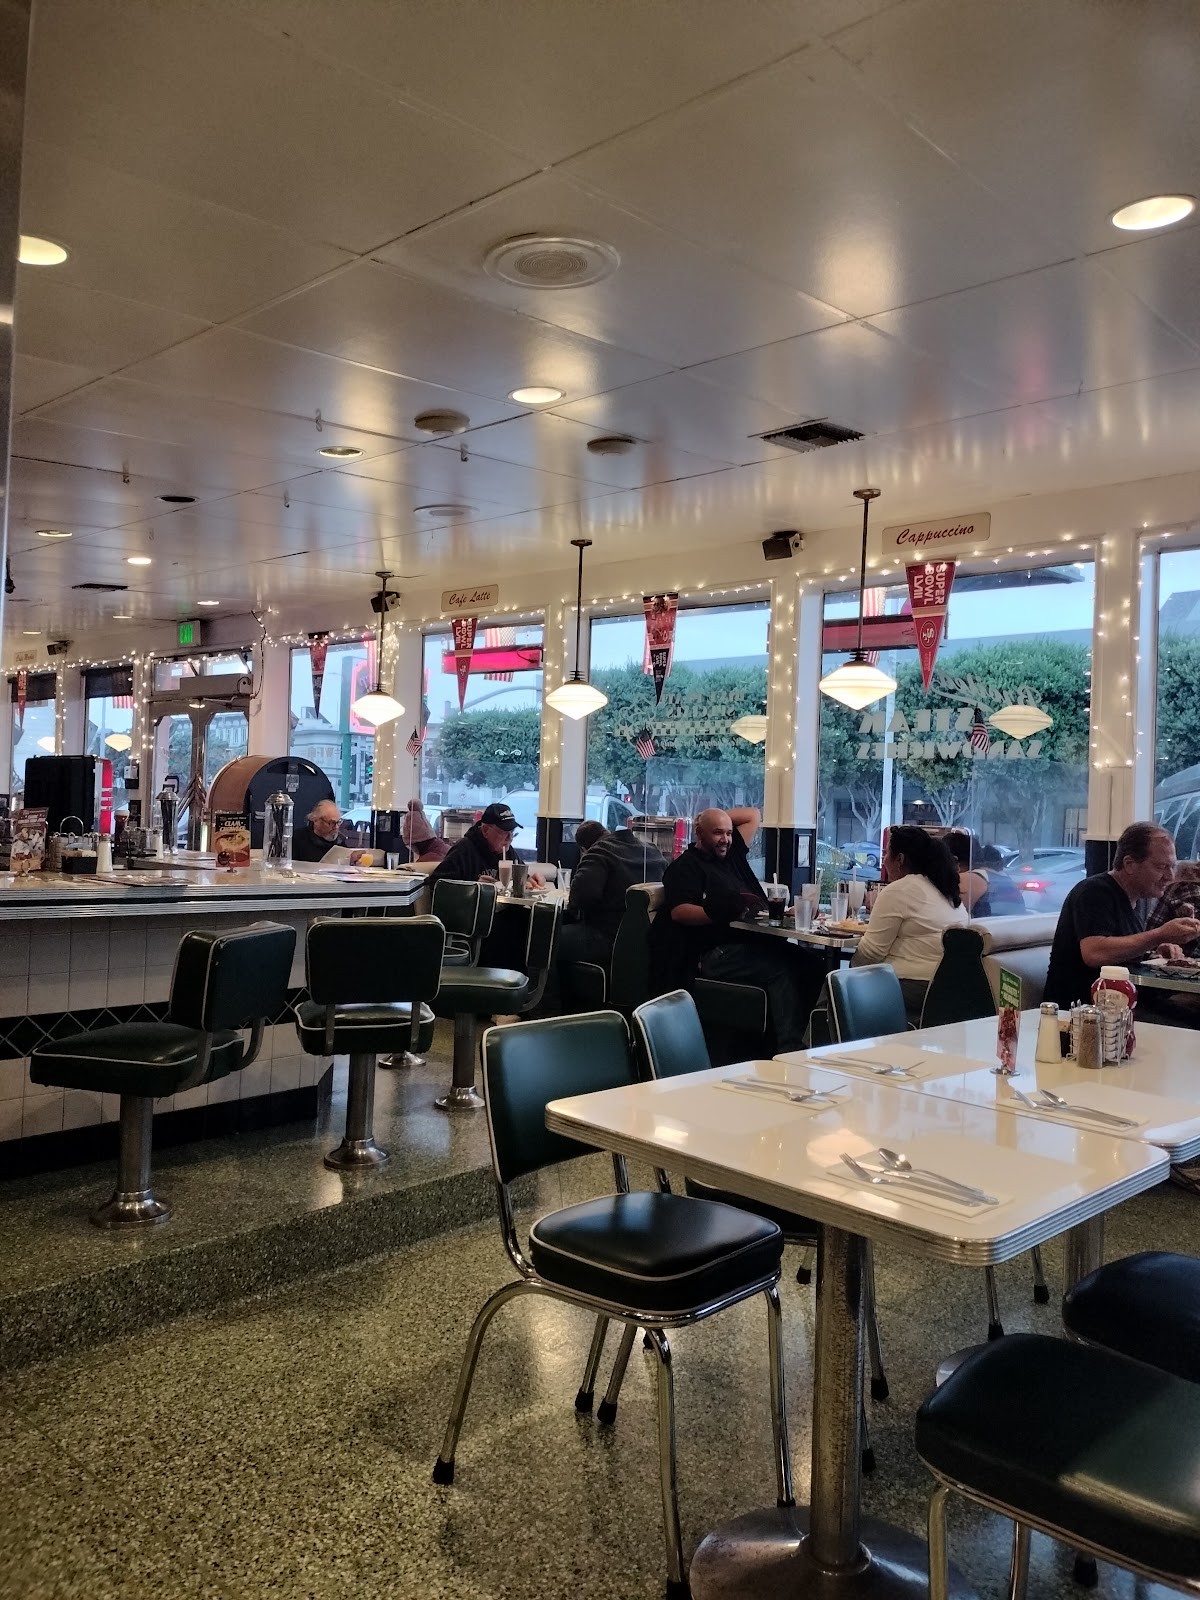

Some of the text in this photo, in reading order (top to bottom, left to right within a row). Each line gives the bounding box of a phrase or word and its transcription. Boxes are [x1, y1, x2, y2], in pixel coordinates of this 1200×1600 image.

[896, 524, 975, 546] Cappuccino
[913, 575, 924, 599] LVIII
[924, 564, 935, 606] BOWL
[934, 563, 946, 605] SUPER
[448, 591, 491, 607] Cafe Latte
